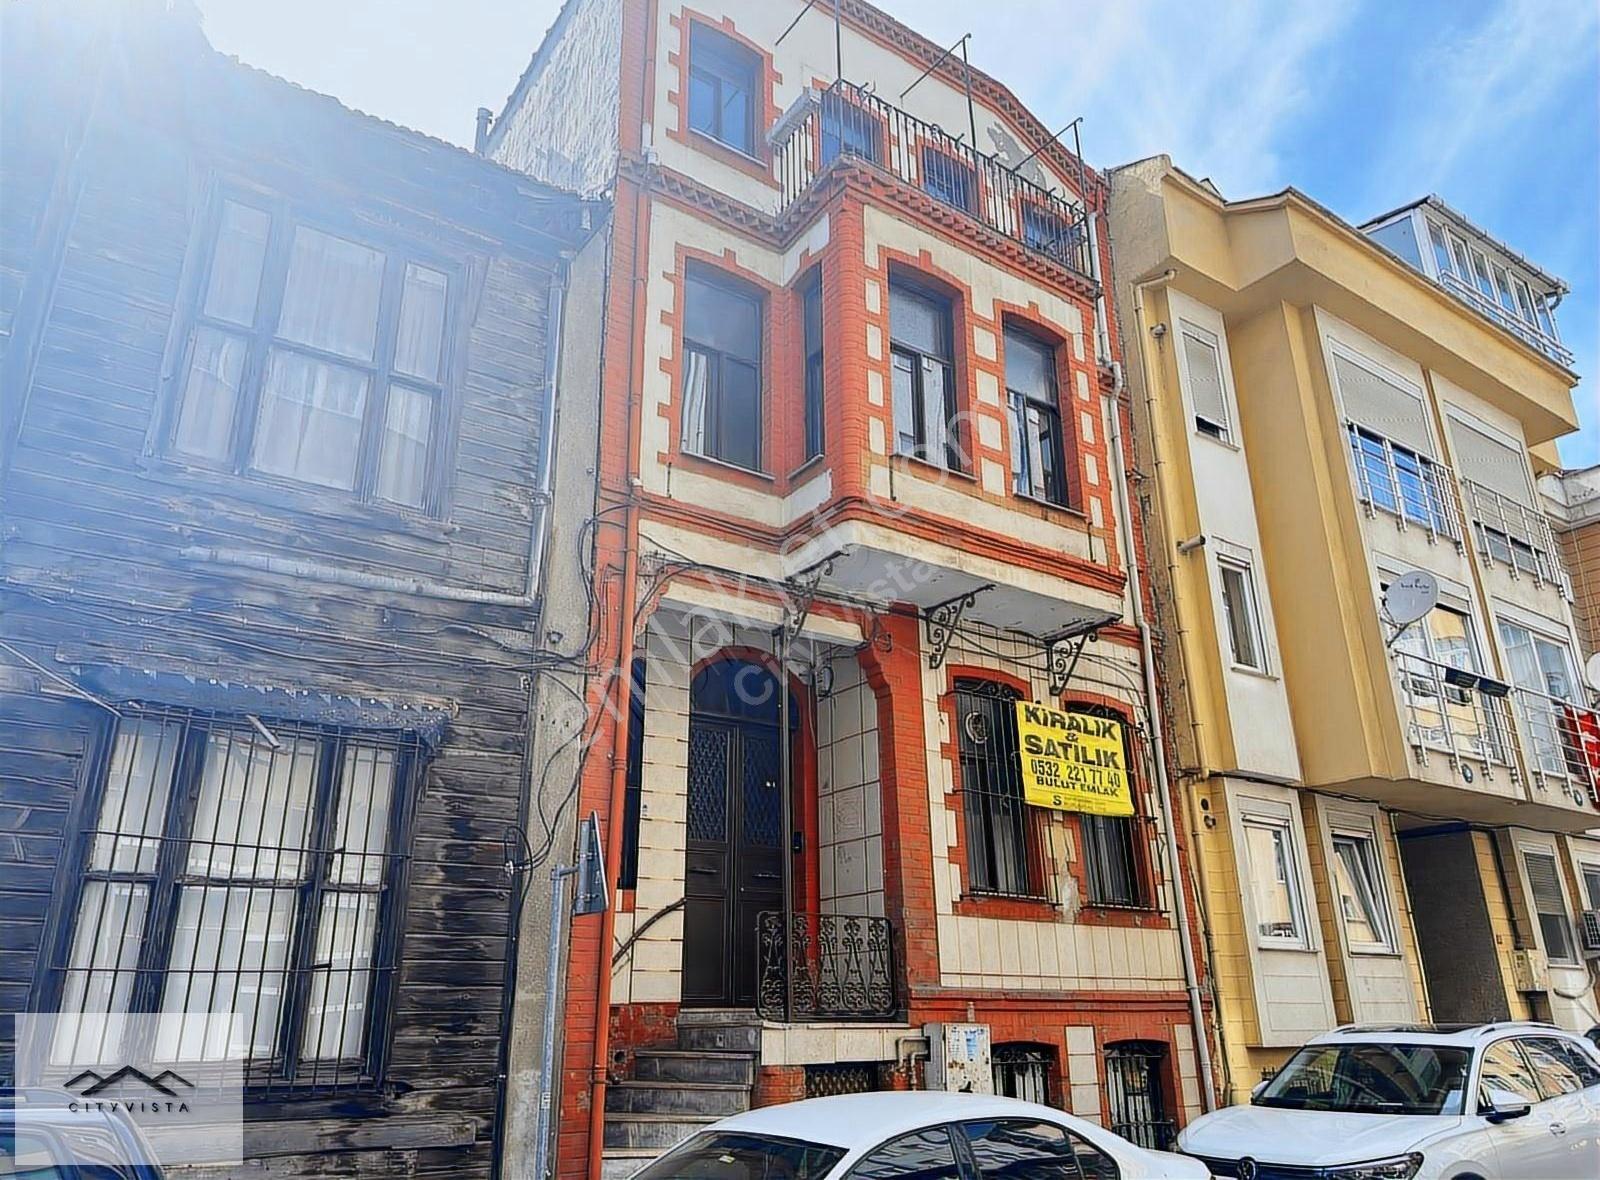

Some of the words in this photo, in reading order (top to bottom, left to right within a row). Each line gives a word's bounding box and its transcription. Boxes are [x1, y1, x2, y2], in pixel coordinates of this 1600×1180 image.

[1065, 732, 1079, 742] &
[1024, 734, 1121, 770] SATILIK
[1030, 758, 1060, 778] 0532
[1066, 765, 1087, 783] 221
[1107, 771, 1121, 788] 40
[1036, 776, 1076, 790] BULUT
[1080, 783, 1119, 797] EMLAK
